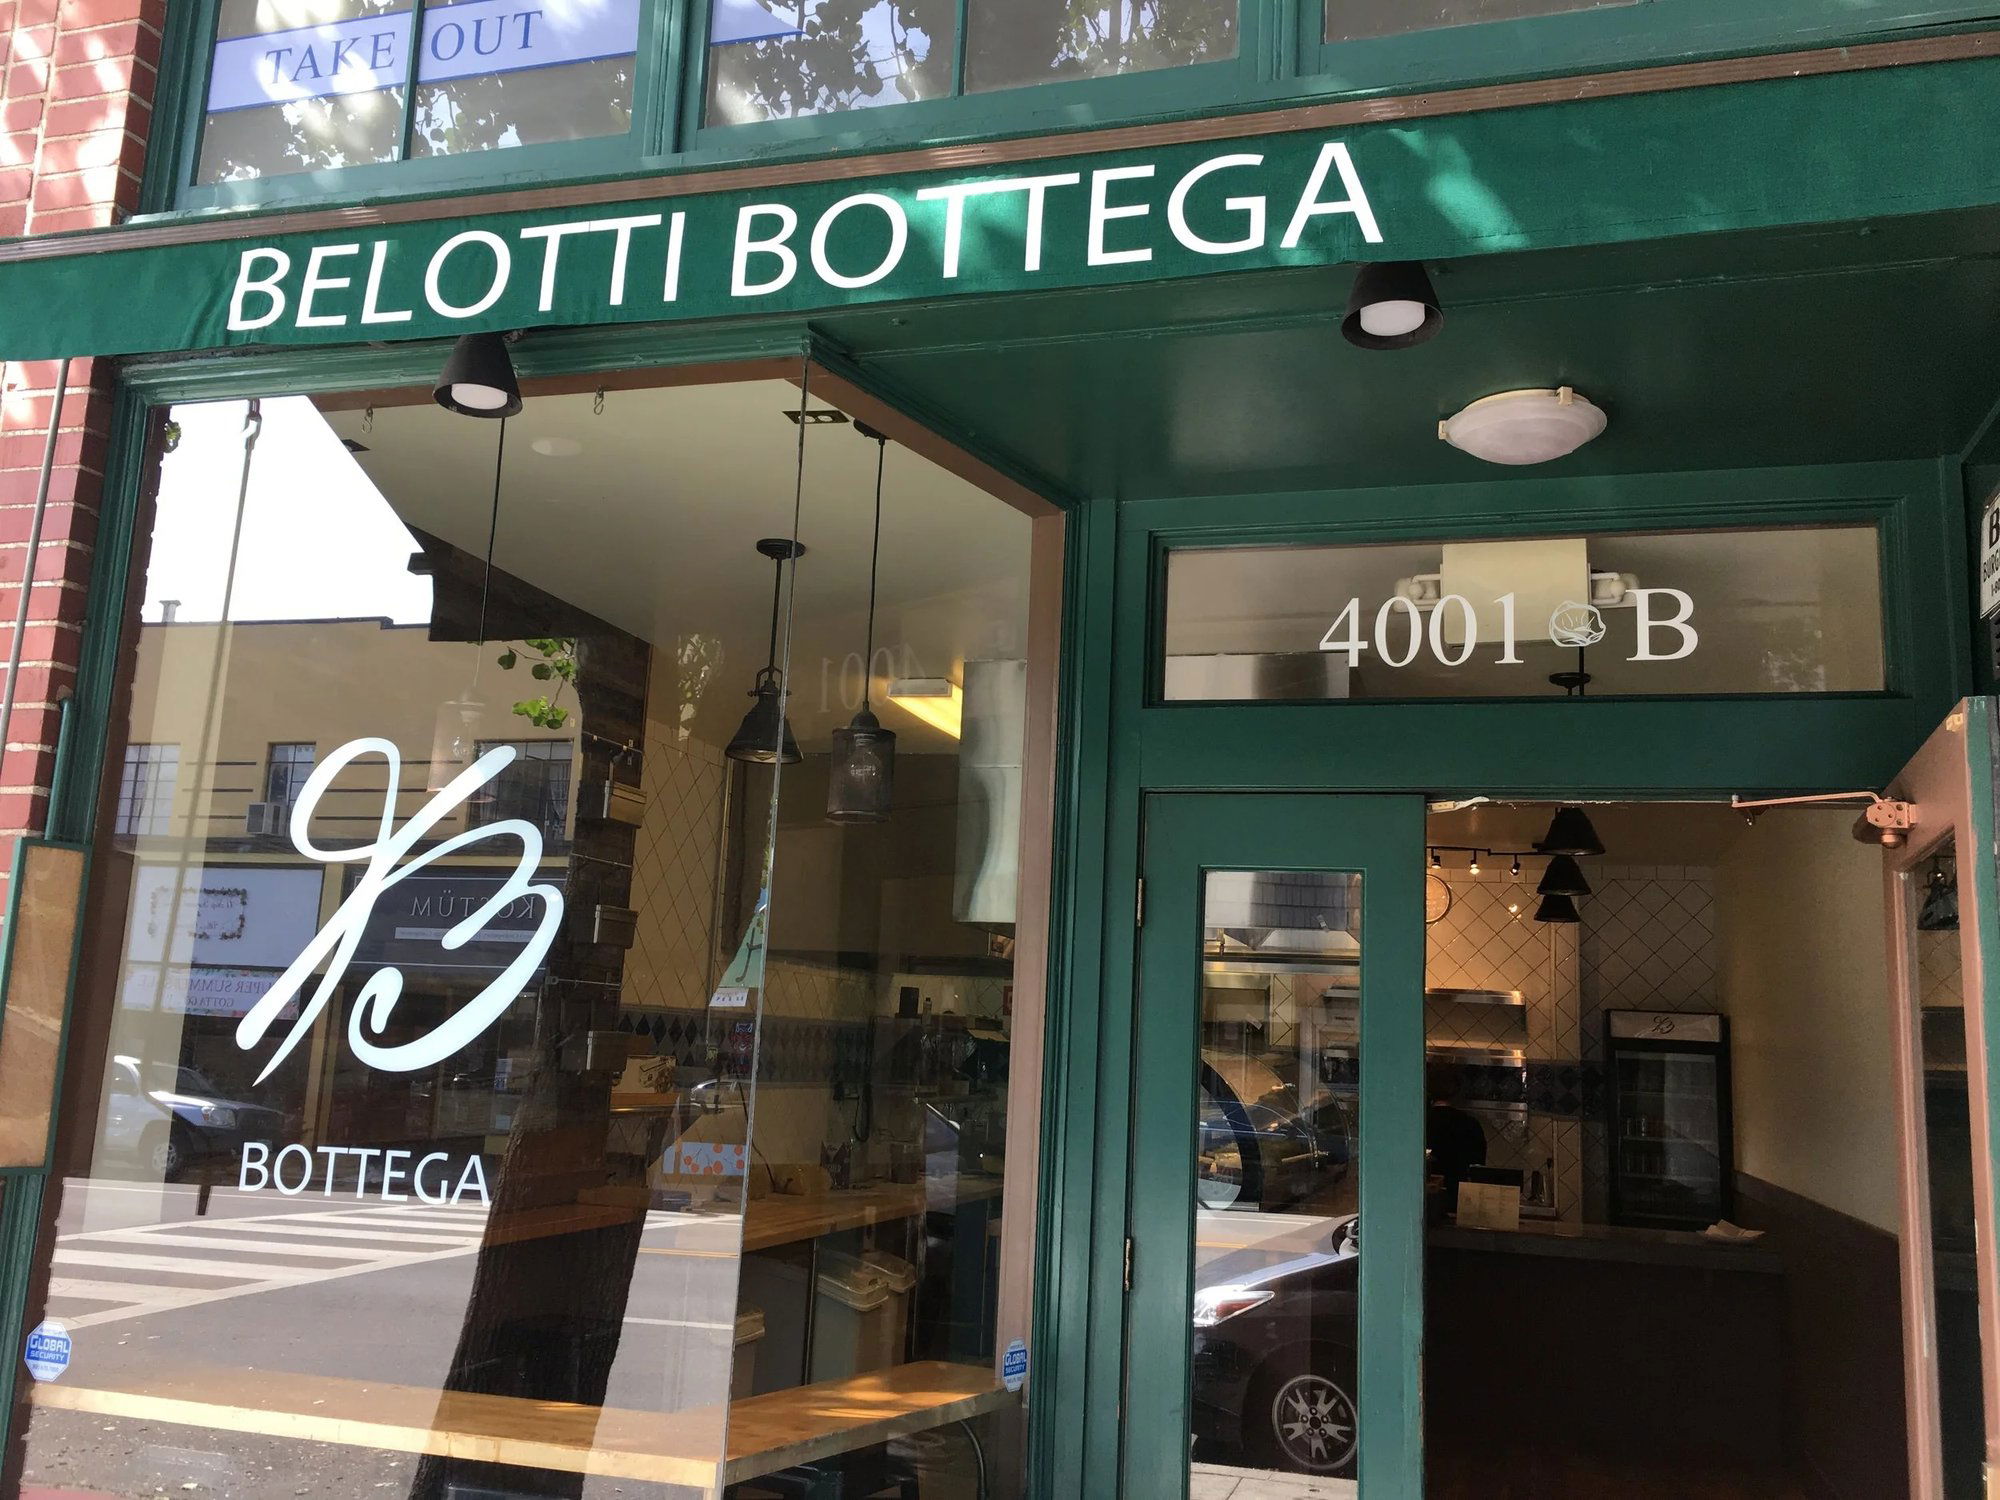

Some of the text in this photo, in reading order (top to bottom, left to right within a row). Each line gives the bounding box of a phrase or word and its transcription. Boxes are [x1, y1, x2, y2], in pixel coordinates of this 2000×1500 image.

[265, 10, 543, 87] TAKE OUT
[227, 142, 1382, 331] BELOTTI BOTTEGA
[1319, 588, 1699, 668] 4001 B
[238, 1142, 491, 1207] BOTTEGA
[30, 1335, 67, 1353] GLOBAL
[30, 1350, 65, 1361] SECURITY
